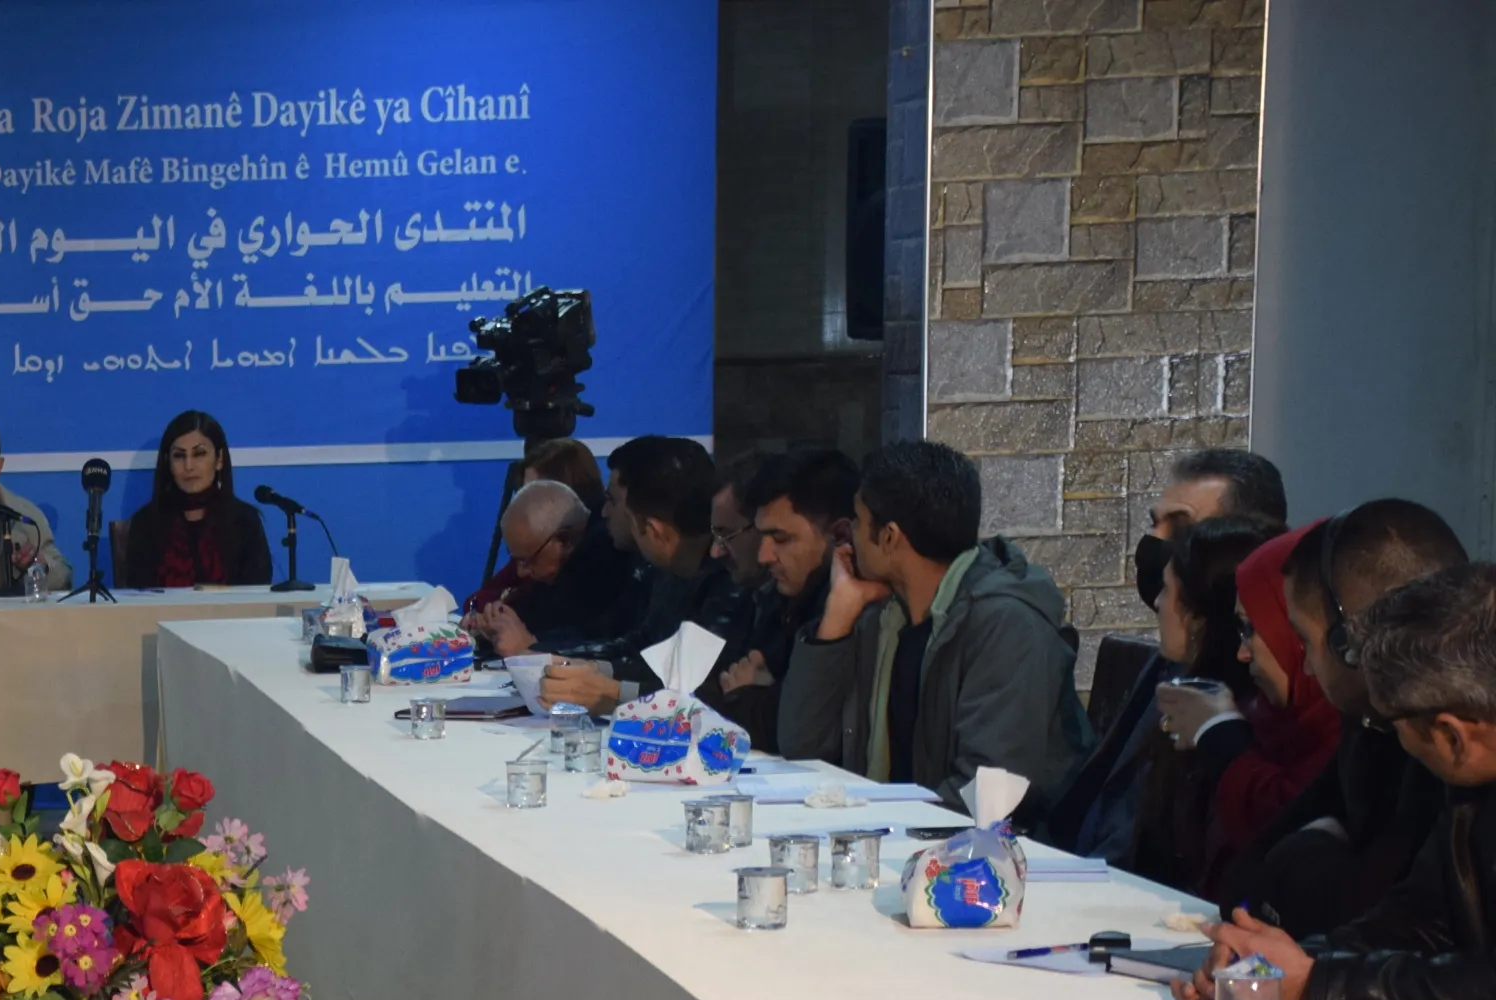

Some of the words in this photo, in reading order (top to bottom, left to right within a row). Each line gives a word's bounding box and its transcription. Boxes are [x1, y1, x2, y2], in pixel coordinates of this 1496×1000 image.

[32, 96, 108, 143] Roja
[116, 91, 243, 131] Zimanê
[252, 87, 366, 138] Dayikê
[374, 97, 412, 136] ya
[420, 83, 530, 123] Cîhanî
[84, 156, 153, 185] Mafê
[161, 154, 288, 190] Bingehîn
[295, 153, 310, 180] ê
[325, 150, 409, 179] Hemû
[416, 148, 497, 176] Gelan
